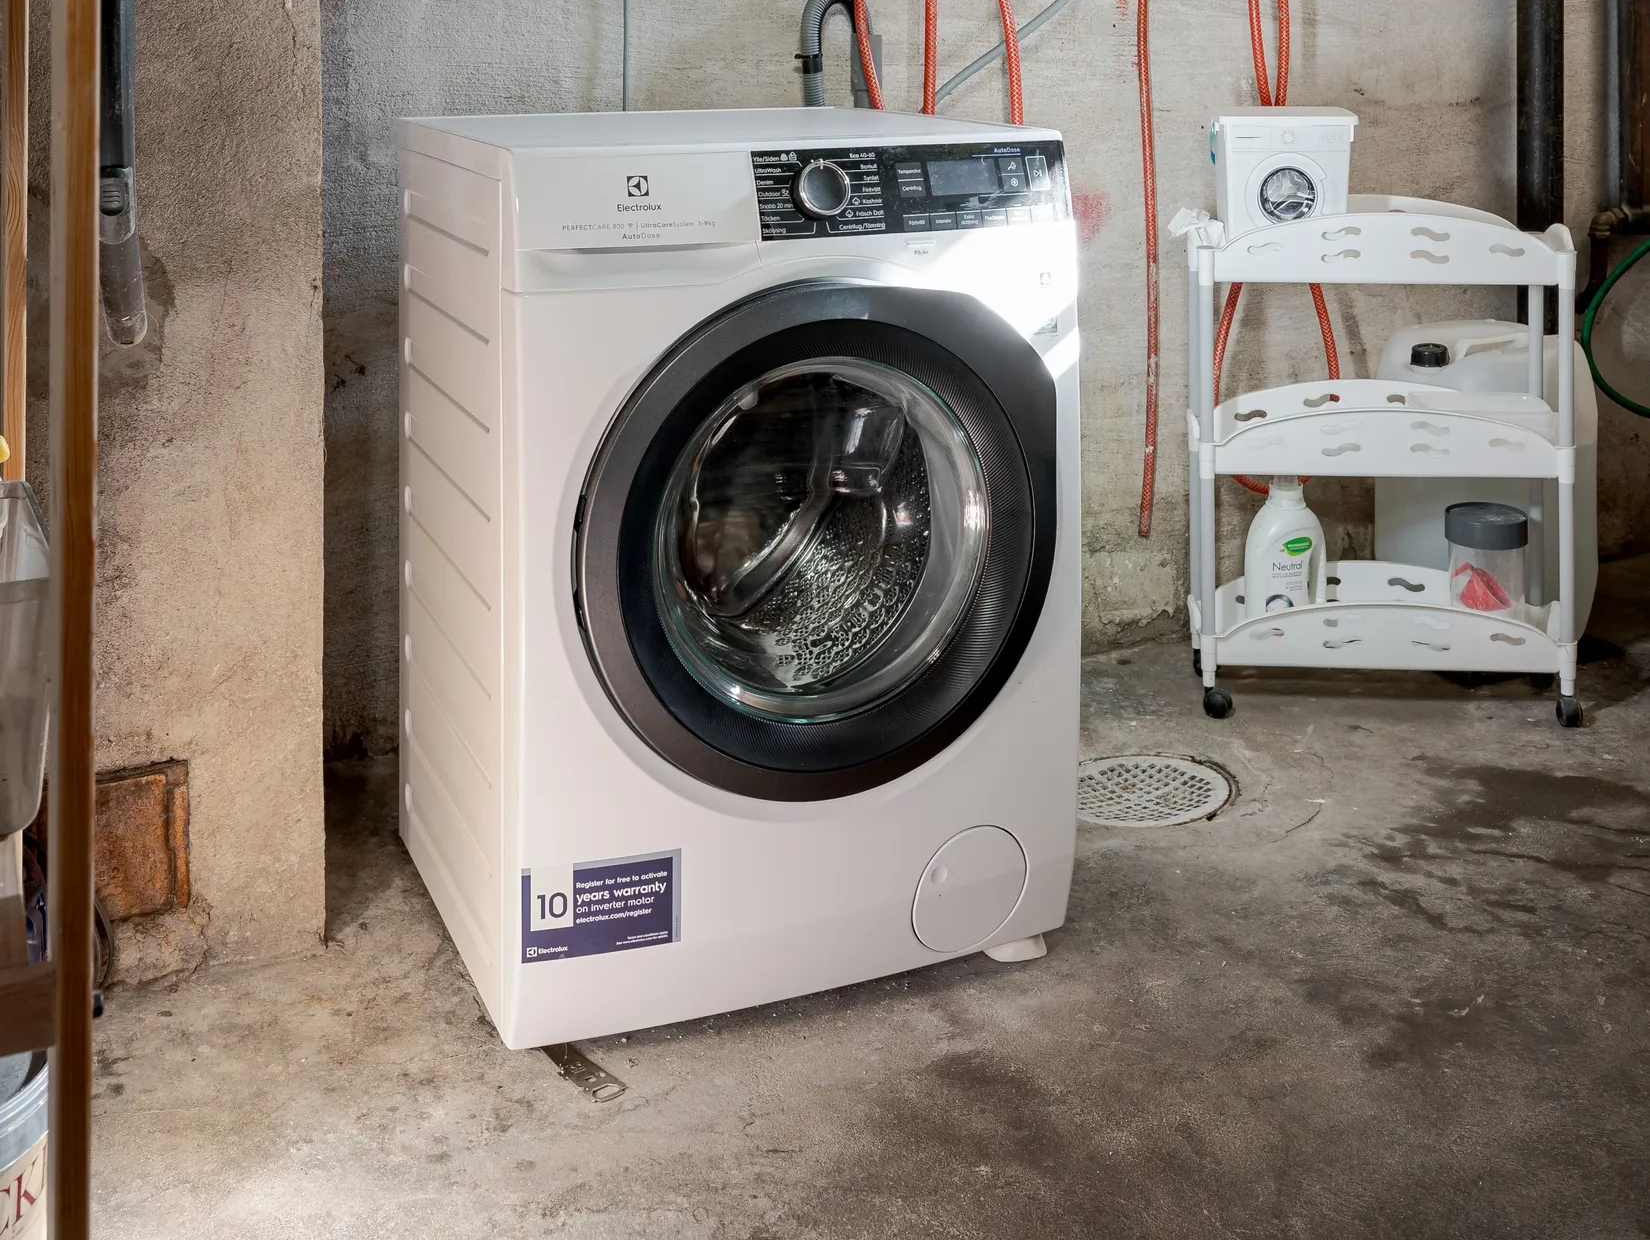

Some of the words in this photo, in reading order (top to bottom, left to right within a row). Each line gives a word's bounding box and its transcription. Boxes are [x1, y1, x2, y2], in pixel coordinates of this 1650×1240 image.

[616, 203, 662, 212] Electrolux
[562, 223, 610, 231] PERFECTCARE
[640, 221, 695, 229] UltraCareSystem
[698, 220, 716, 228] 1-9kg
[622, 232, 661, 240] AutoDose
[1272, 560, 1303, 571] Neutral
[575, 879, 603, 889] Register
[605, 877, 615, 885] for
[640, 870, 668, 880] activate
[576, 889, 610, 905] years
[613, 881, 667, 898] warranty
[536, 892, 568, 920] 10
[576, 905, 588, 914] on
[590, 900, 626, 912] inverter
[627, 895, 655, 907] motor
[575, 907, 652, 924] electrolux.com/register
[538, 945, 568, 955] Electrolux
